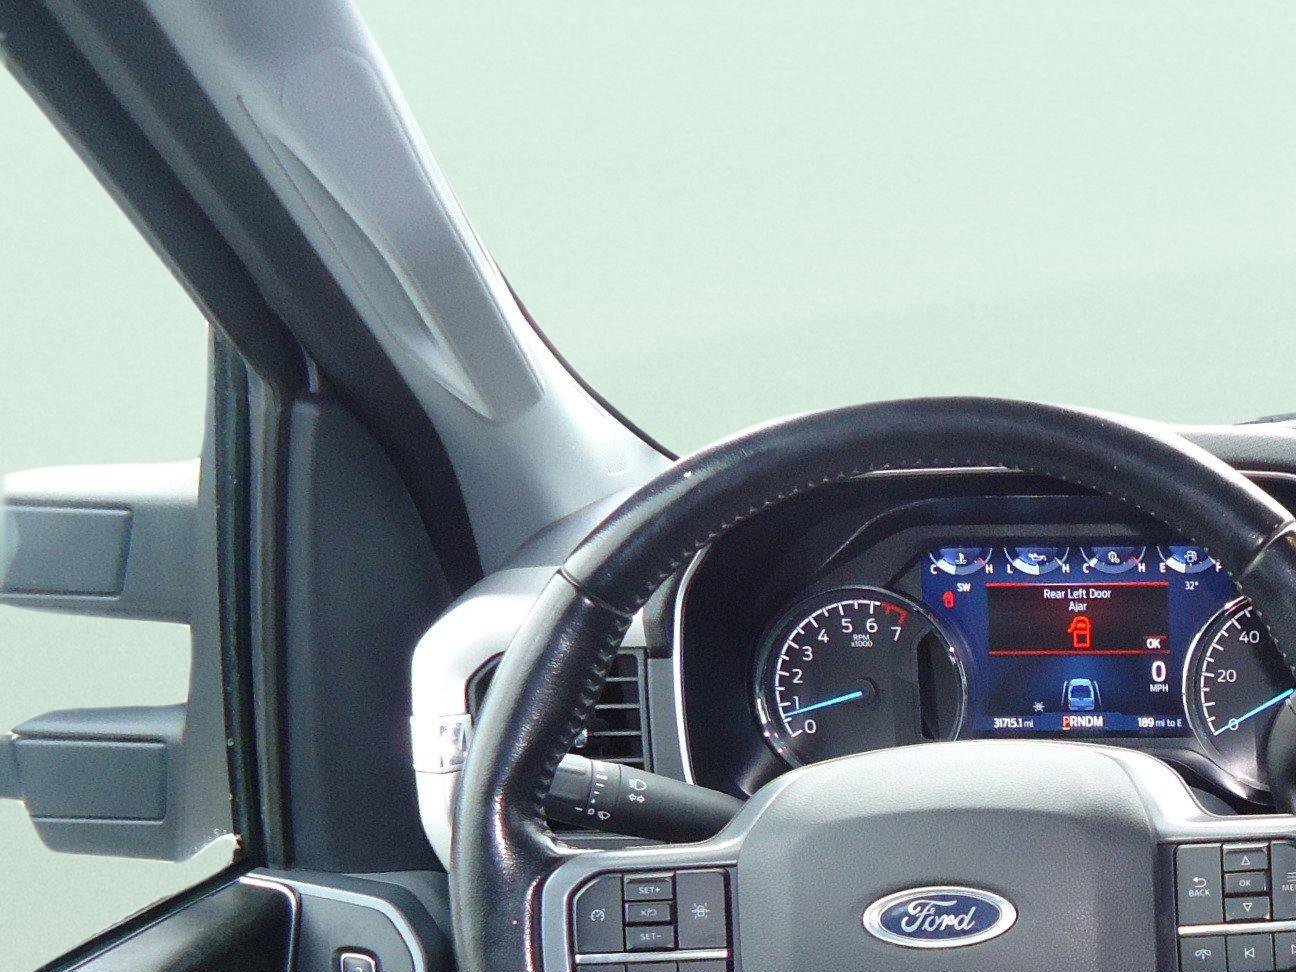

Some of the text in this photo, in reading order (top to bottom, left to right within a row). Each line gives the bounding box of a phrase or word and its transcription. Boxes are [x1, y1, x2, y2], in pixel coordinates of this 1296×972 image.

[930, 563, 938, 575] C
[985, 562, 994, 574] H
[1006, 563, 1014, 575] L
[1062, 562, 1070, 574] H
[1082, 563, 1090, 574] C
[1138, 562, 1146, 573] H
[1159, 562, 1167, 573] E
[956, 582, 971, 593] SW
[1043, 587, 1112, 599] Rear Left Door
[1068, 600, 1087, 612] Ajar
[841, 618, 853, 633] 5
[866, 618, 878, 633] 6
[817, 628, 830, 643] 4
[890, 626, 902, 641] 7
[1238, 630, 1260, 644] 40
[1146, 638, 1161, 649] OK
[802, 646, 813, 661] 3
[792, 668, 803, 683] 2
[1151, 661, 1166, 683] 0
[1217, 669, 1237, 683] 20
[1149, 684, 1168, 693] MPH
[793, 696, 800, 712] 1
[804, 719, 817, 734] 0
[1024, 718, 1034, 728] mi
[1137, 717, 1182, 728] 189 mi to E
[1228, 718, 1239, 731] 0
[1238, 879, 1251, 887] OK
[1188, 889, 1211, 897] BACK
[901, 899, 976, 933] Ford
